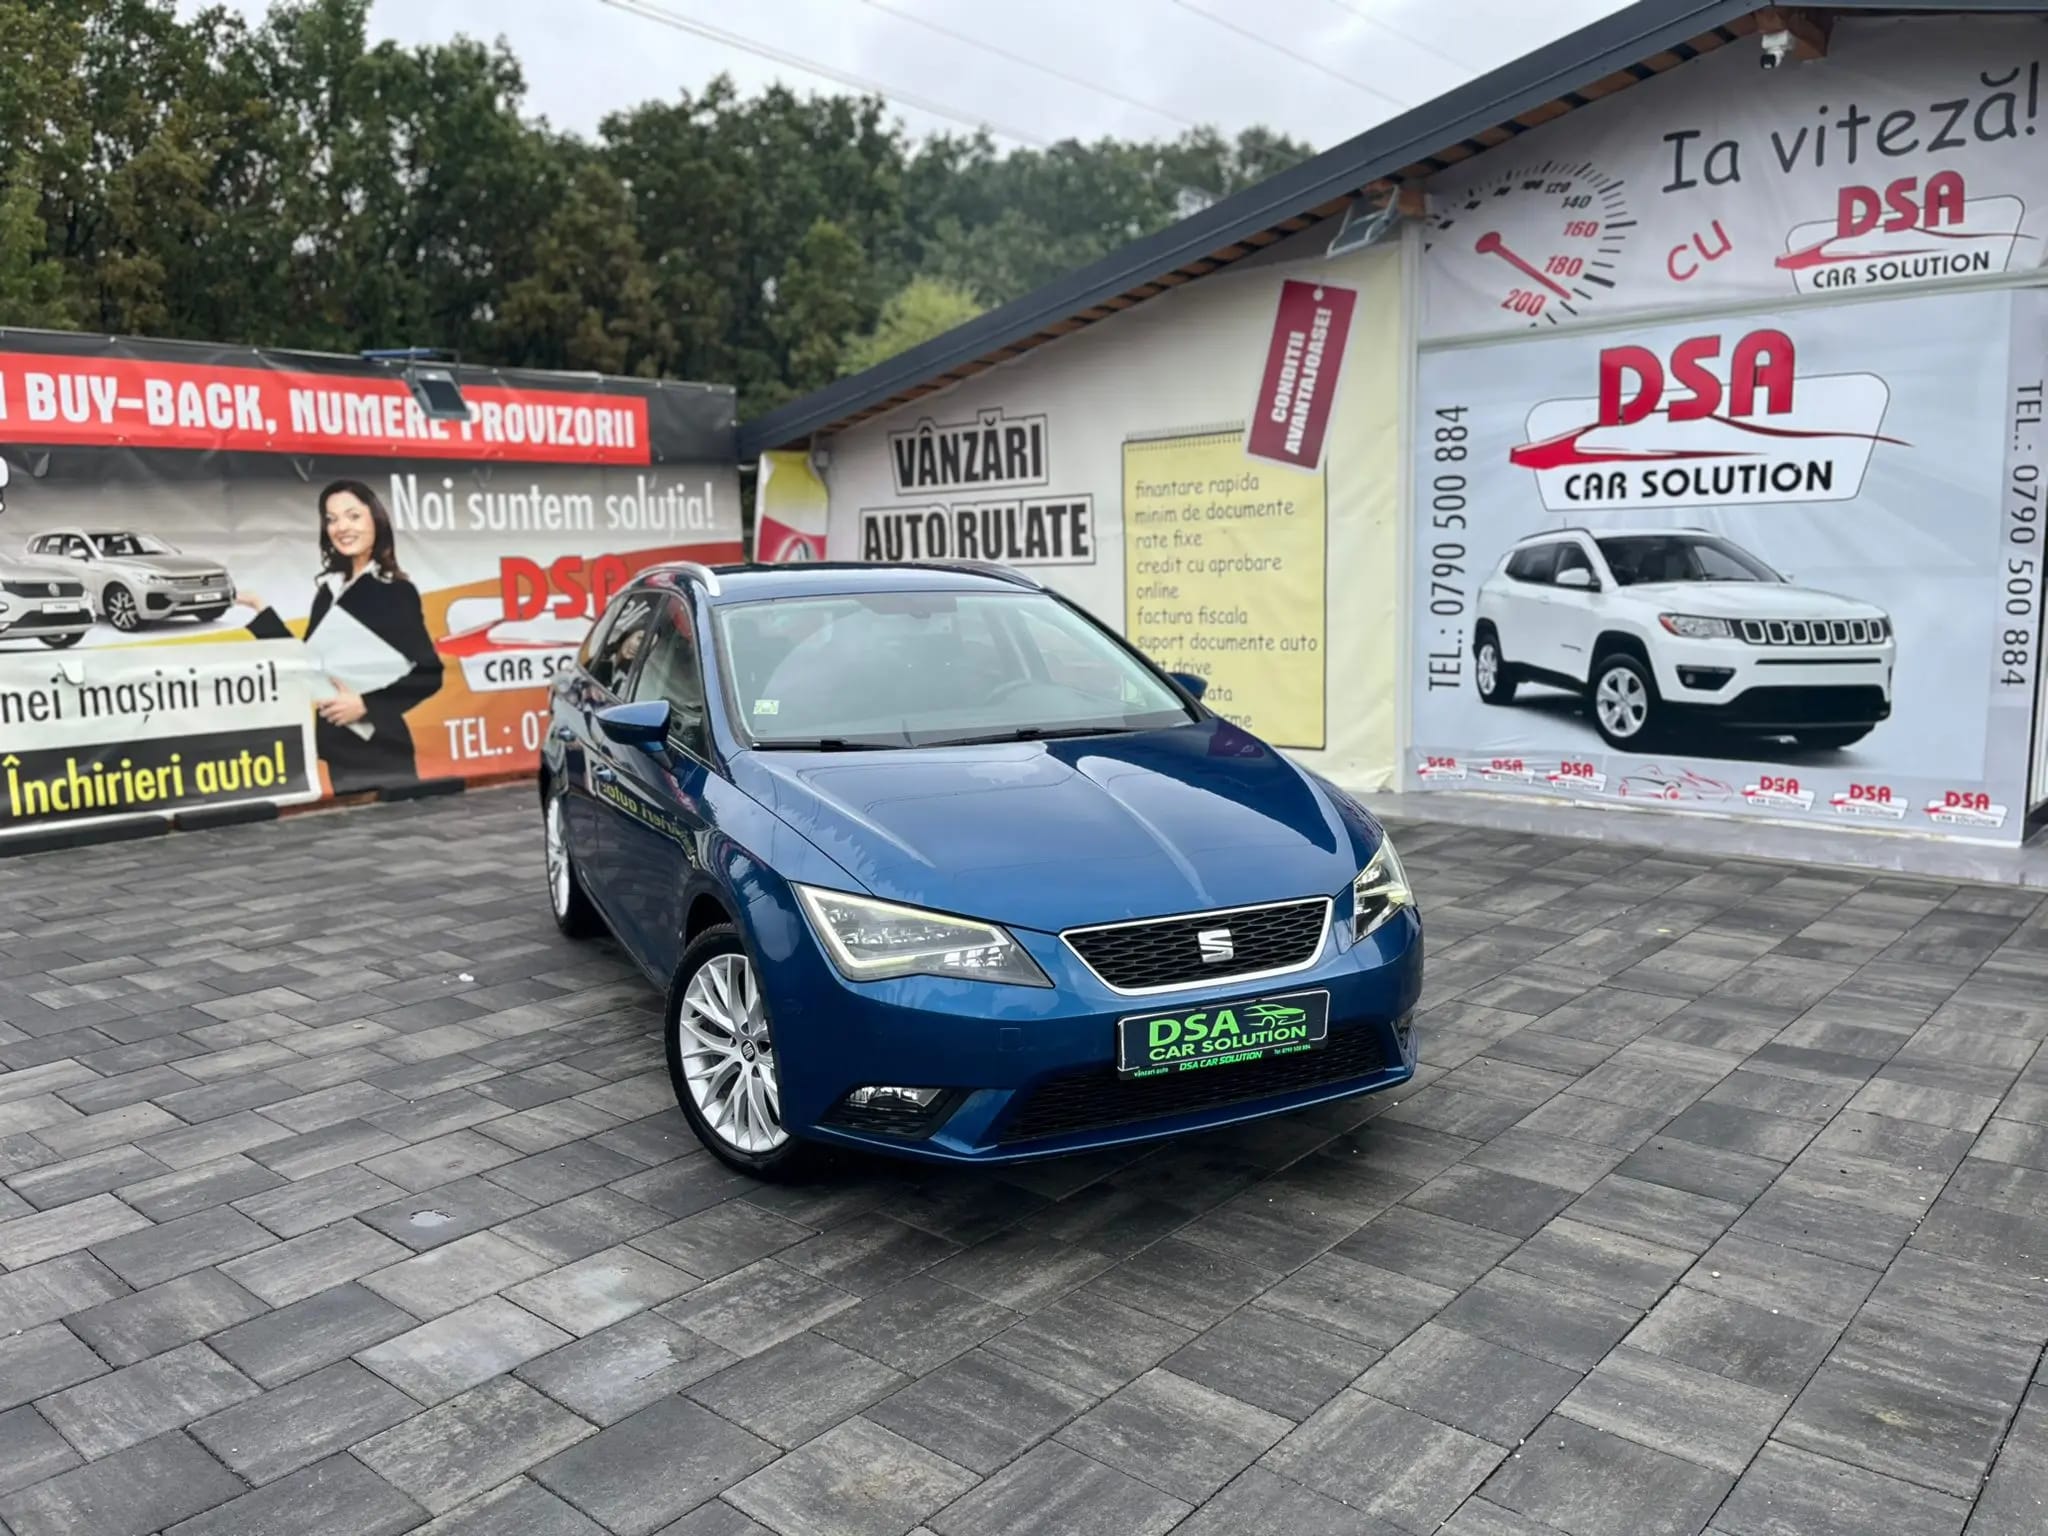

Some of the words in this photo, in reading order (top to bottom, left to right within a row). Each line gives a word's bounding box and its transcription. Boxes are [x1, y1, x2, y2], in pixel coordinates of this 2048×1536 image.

[1662, 129, 1740, 193] Ia
[1771, 61, 2040, 173] viteză!
[1561, 195, 1592, 208] 140
[1838, 170, 1965, 239] DSA
[1563, 221, 1599, 238] 160
[1545, 256, 1584, 277] 180
[1667, 220, 1733, 281] cu
[1812, 265, 1857, 289] CAR
[1866, 250, 1991, 283] SOLUTION
[1501, 288, 1546, 317] 200
[1600, 329, 1795, 427] DSA
[25, 372, 277, 434] BUY-BACK,
[461, 400, 636, 448] PROVIZORII
[2013, 380, 2043, 451] TEL.:
[895, 416, 1042, 488] VÂNZĂRI
[1434, 405, 1469, 462] 884
[1135, 480, 1203, 498] finantare
[1209, 472, 1259, 497] rapida
[1565, 473, 1627, 501] CAR
[1641, 461, 1833, 498] SOLUTION
[390, 473, 455, 531] Noi
[468, 484, 594, 531] suntem
[1135, 505, 1177, 523] minim
[1182, 504, 1200, 521] de
[1206, 499, 1295, 520] documente
[1432, 474, 1467, 530] 500
[2009, 464, 2039, 544] 0790
[864, 511, 947, 562] AUTO
[956, 503, 1090, 560] RULATE
[1136, 533, 1168, 549] rate
[1174, 529, 1203, 548] fixe
[1136, 557, 1181, 574] credit
[1187, 560, 1204, 573] cu
[1209, 552, 1282, 578] aprobare
[1430, 543, 1466, 616] 0790
[1136, 582, 1179, 599] online
[2006, 558, 2034, 616] 500
[1137, 606, 1193, 626] factura
[1198, 604, 1248, 625] fiscala
[1137, 635, 1184, 655] suport
[1190, 631, 1275, 651] documente
[1280, 636, 1318, 651] auto
[1428, 628, 1463, 692] TEL.:
[2001, 628, 2030, 686] 884
[485, 658, 532, 682] CAR
[1172, 657, 1212, 675] drive
[79, 668, 199, 723] mașini
[215, 661, 278, 707] noi!
[444, 716, 513, 761] TEL.:
[2, 754, 184, 816] Închirieri
[196, 741, 287, 794] auto!
[1561, 761, 1594, 777] DSA
[1760, 776, 1799, 794] DSA
[1850, 784, 1891, 802] DSA
[1945, 791, 1990, 810] DSA
[1149, 1009, 1240, 1047] DSA
[1149, 1043, 1195, 1061] CAR
[1202, 1025, 1307, 1053] SOLUTION
[1179, 1061, 1199, 1071] DSA
[1200, 1058, 1218, 1068] CAR
[1219, 1051, 1263, 1064] SOLUTION
